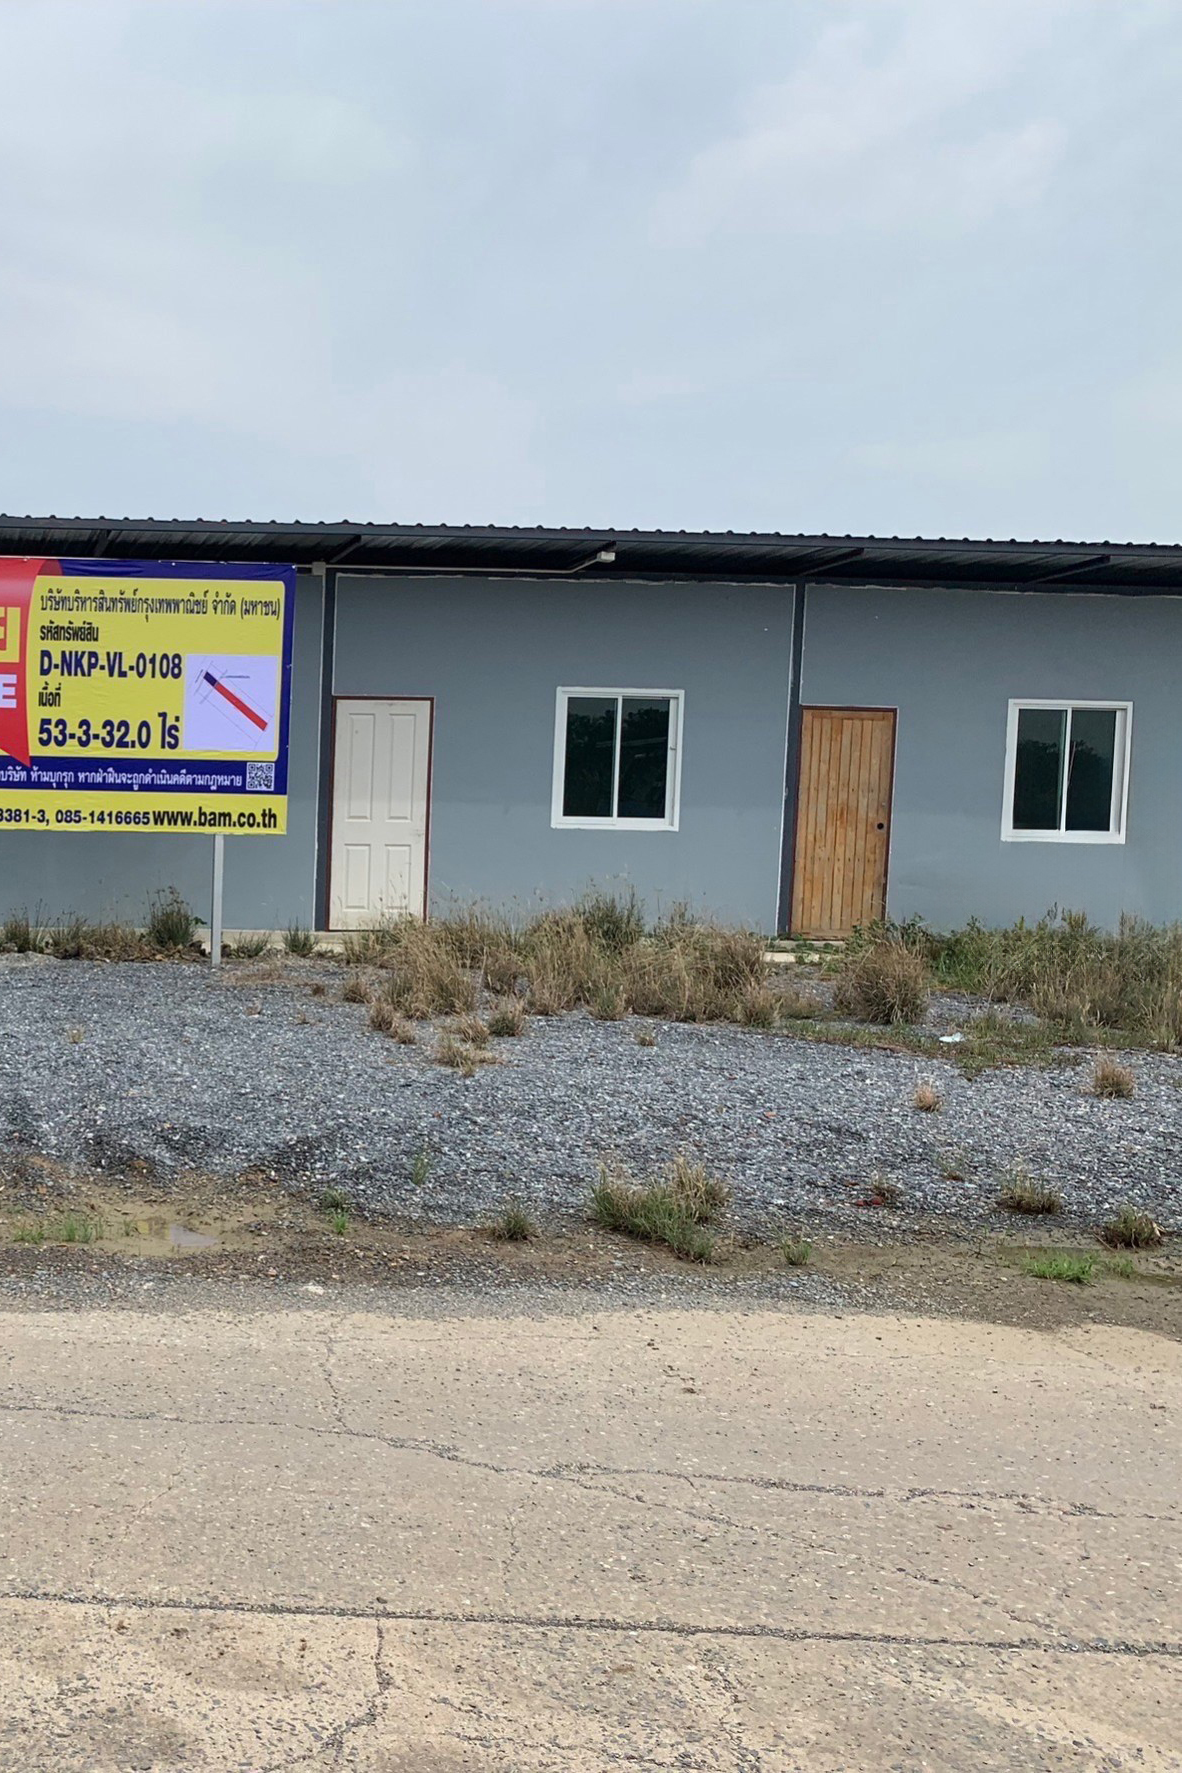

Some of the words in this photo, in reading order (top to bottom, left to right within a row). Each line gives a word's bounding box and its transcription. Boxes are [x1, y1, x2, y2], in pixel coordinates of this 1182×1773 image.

[212, 591, 237, 616] จำกัด
[240, 597, 281, 621] (มหาชน)
[39, 620, 99, 642] รหัสทรัพย์สิน
[39, 649, 182, 679] D-NKP-VL-0108
[38, 681, 62, 708] เนื้อที่
[38, 717, 152, 749] 53-3-32.0
[157, 711, 181, 750] ไร่
[30, 766, 75, 789] ห้ามบุกรุก
[55, 809, 150, 825] 085-1416665
[152, 806, 277, 829] www.bam.co.th
